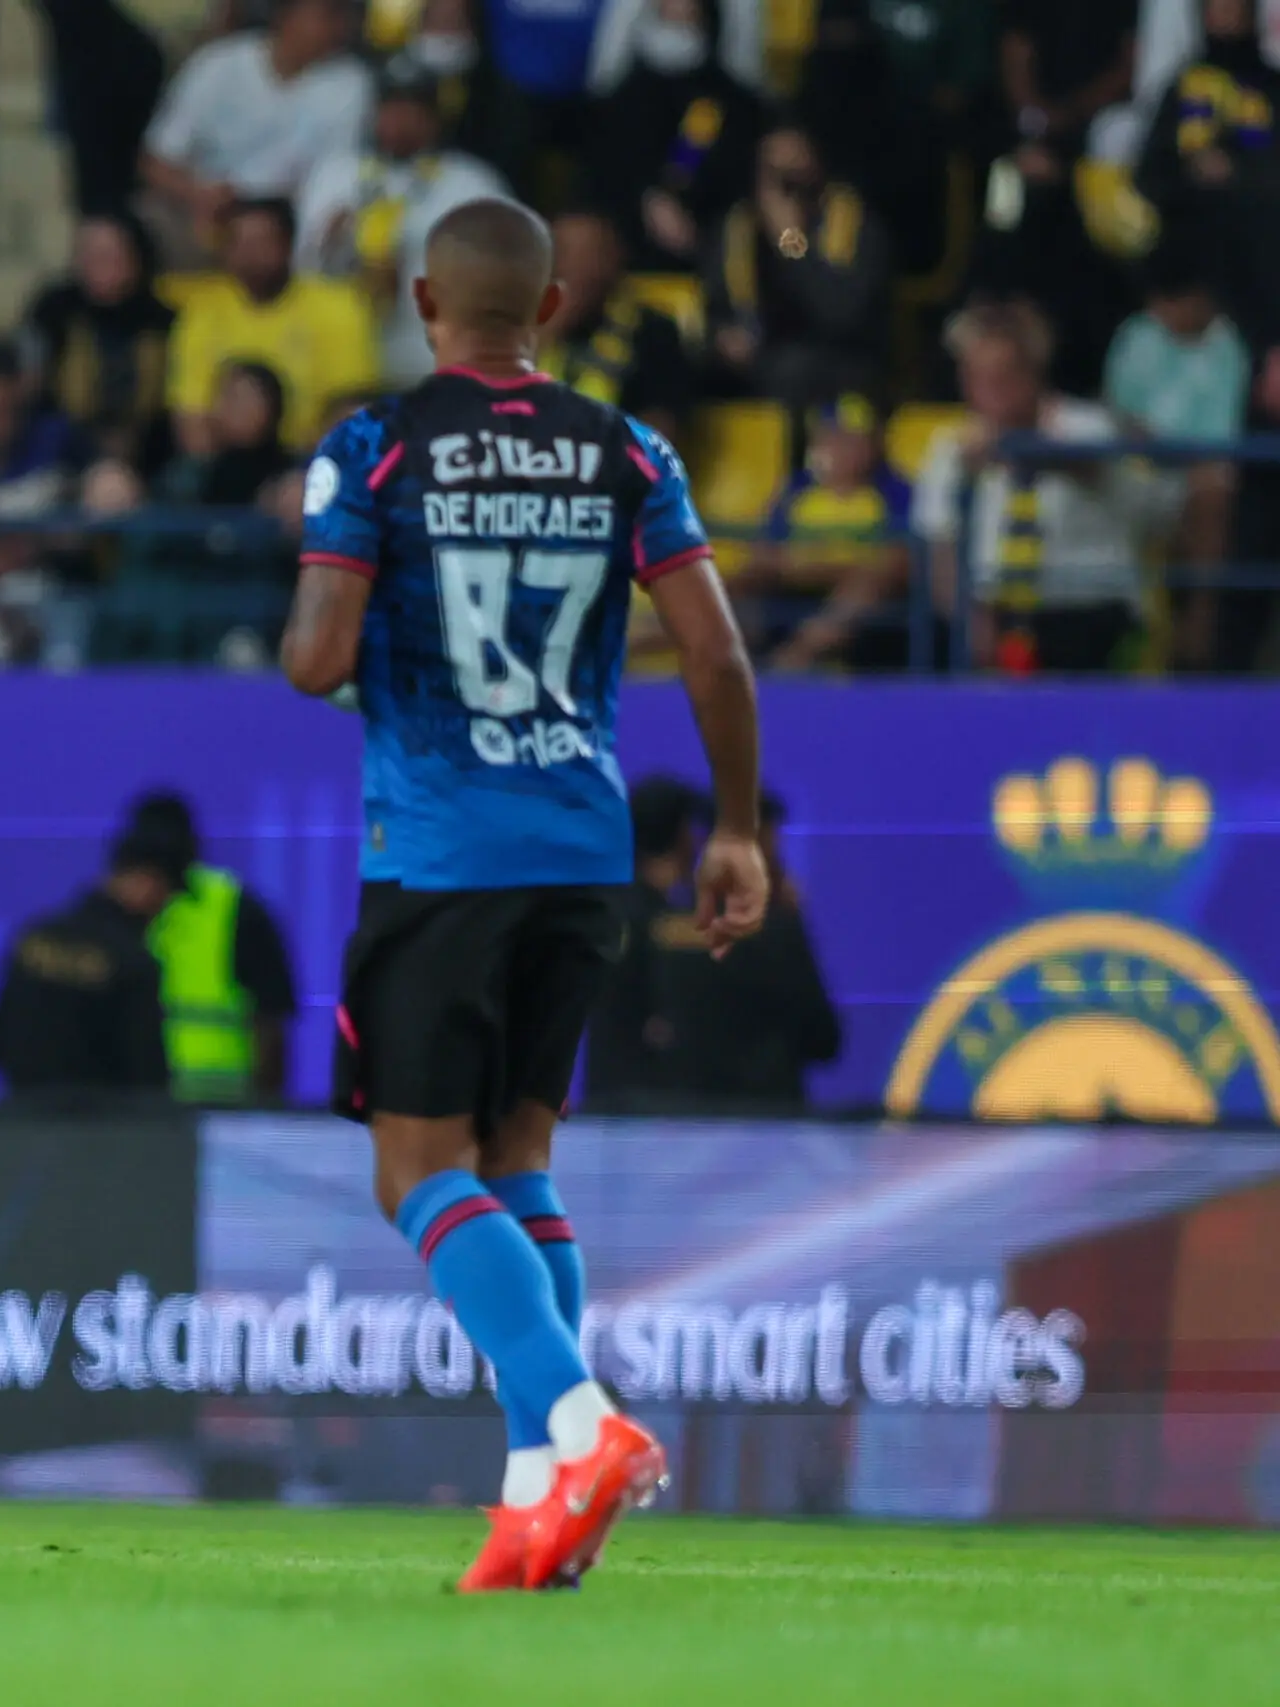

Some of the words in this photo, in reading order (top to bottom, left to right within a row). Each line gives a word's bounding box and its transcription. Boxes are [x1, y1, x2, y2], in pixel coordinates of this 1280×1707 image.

[429, 430, 603, 485] الطازج
[423, 492, 471, 537] DE
[474, 492, 614, 540] MORAES
[611, 1282, 850, 1404] smart
[860, 1277, 1086, 1408] cities
